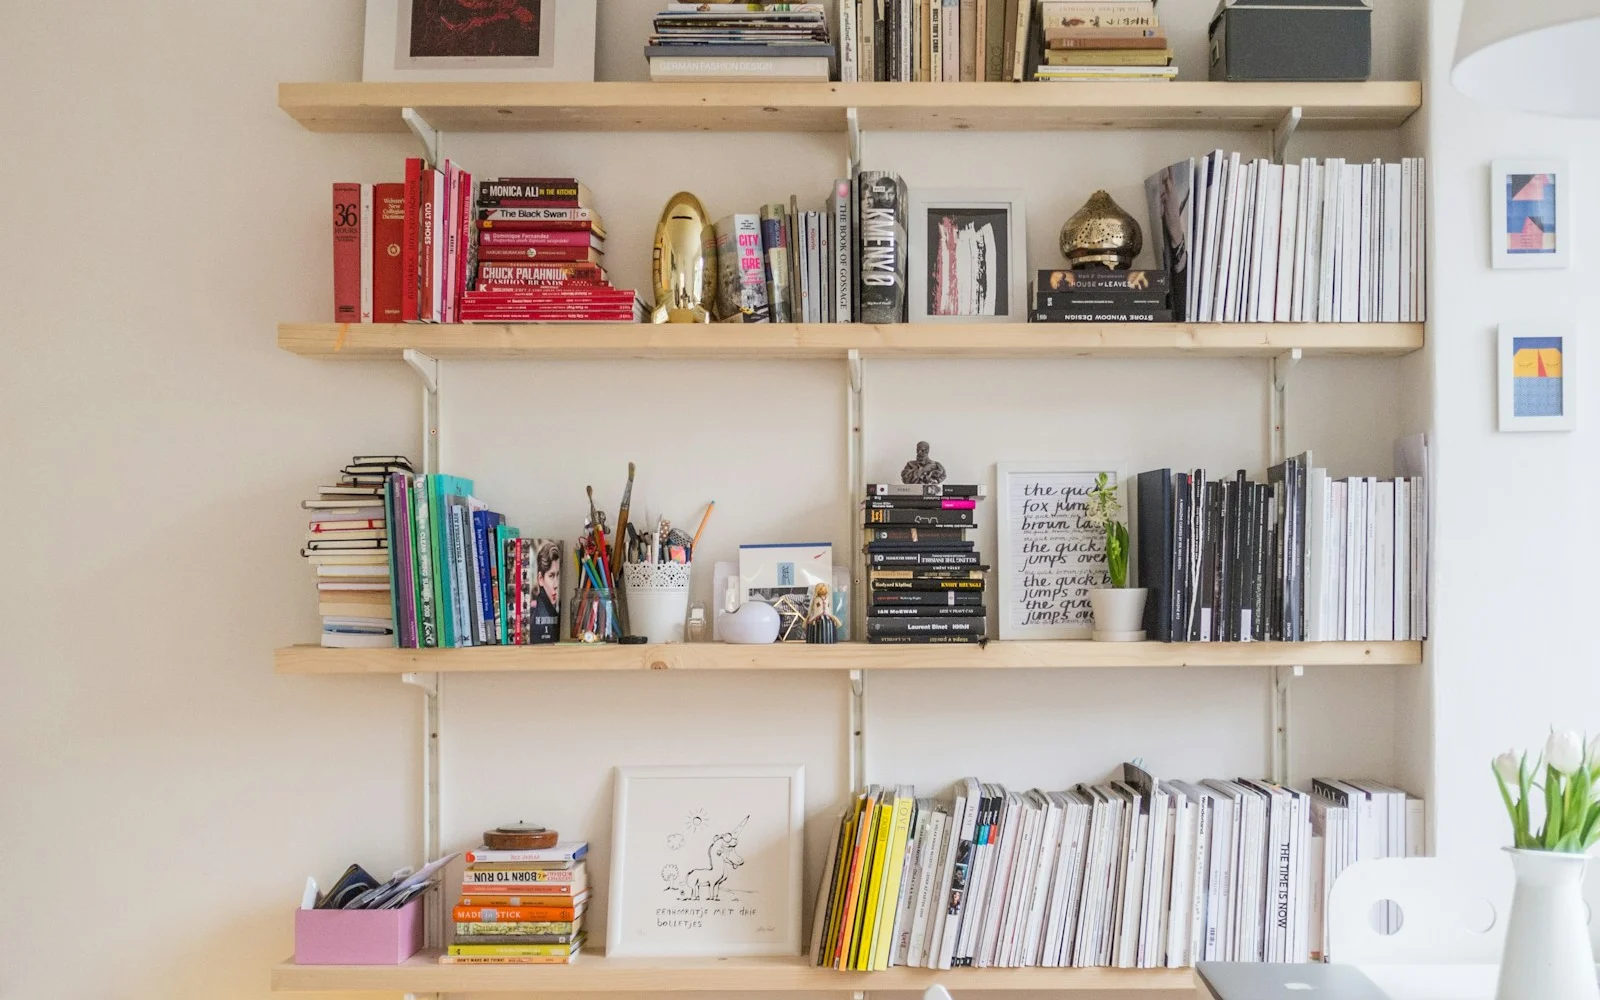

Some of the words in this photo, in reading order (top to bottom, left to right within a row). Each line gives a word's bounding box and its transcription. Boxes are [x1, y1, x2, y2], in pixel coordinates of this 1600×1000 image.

[659, 62, 699, 71] GERMAN
[700, 62, 738, 71] FASHION
[740, 62, 773, 71] DESIGN
[489, 185, 522, 197] MONICA
[525, 186, 539, 198] ALI
[335, 203, 358, 227] 36
[500, 209, 516, 218] The
[518, 209, 541, 218] Black
[543, 210, 567, 218] Swan
[839, 203, 847, 222] THE
[738, 234, 759, 247] CITY
[839, 225, 847, 251] BOOK
[863, 208, 895, 272] KMENY
[745, 248, 755, 257] ON
[839, 254, 847, 266] OF
[741, 258, 761, 270] FIRE
[482, 267, 514, 280] CHUCK
[515, 267, 568, 281] PALAHNIUK
[839, 268, 847, 310] GOSSAGE
[1023, 482, 1058, 496] the
[1060, 485, 1100, 504] quic
[1022, 499, 1049, 514] fox
[419, 531, 428, 553] CLEAN
[1022, 541, 1051, 554] the
[1055, 539, 1101, 561] quick
[1018, 553, 1069, 572] jumps
[1023, 574, 1052, 588] the
[1055, 573, 1098, 596] quick
[1019, 588, 1069, 603] jumps
[1025, 600, 1055, 610] the
[1059, 599, 1093, 616] quic
[1021, 610, 1071, 625] jumps
[1075, 611, 1095, 620] ove
[898, 800, 909, 831] LOVE
[1280, 842, 1290, 862] THE
[473, 872, 494, 882] RUN
[497, 871, 510, 881] TO
[512, 871, 537, 881] BORN
[1279, 864, 1289, 888] TIME
[1279, 889, 1288, 900] IS
[457, 911, 482, 919] MADE
[496, 911, 521, 919] STICK
[1278, 901, 1287, 929] NOW
